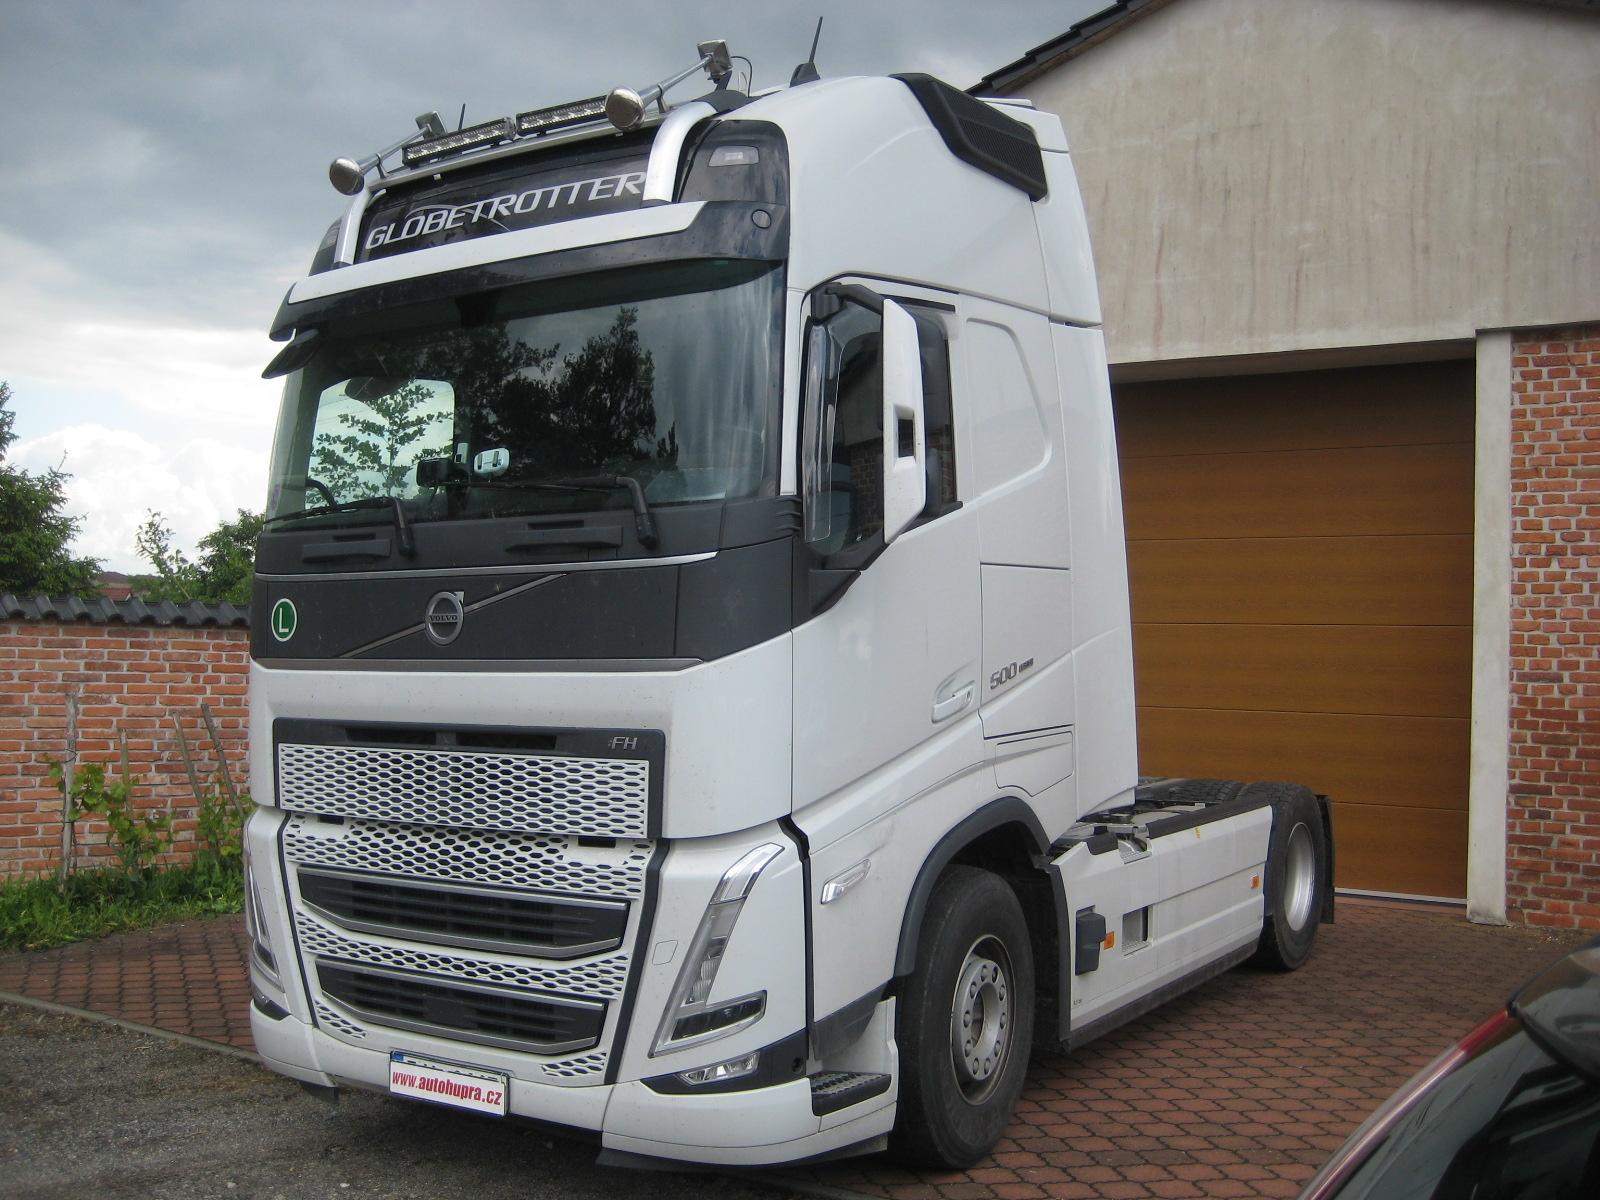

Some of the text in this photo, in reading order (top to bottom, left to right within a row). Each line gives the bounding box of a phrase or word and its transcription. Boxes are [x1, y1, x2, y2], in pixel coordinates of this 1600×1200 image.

[365, 171, 647, 250] GLOBETROTTER
[278, 607, 290, 633] L
[429, 614, 458, 622] VOLVO
[989, 661, 1017, 690] 500
[611, 736, 638, 750] FH
[392, 1071, 503, 1106] www.autohupra.cz
